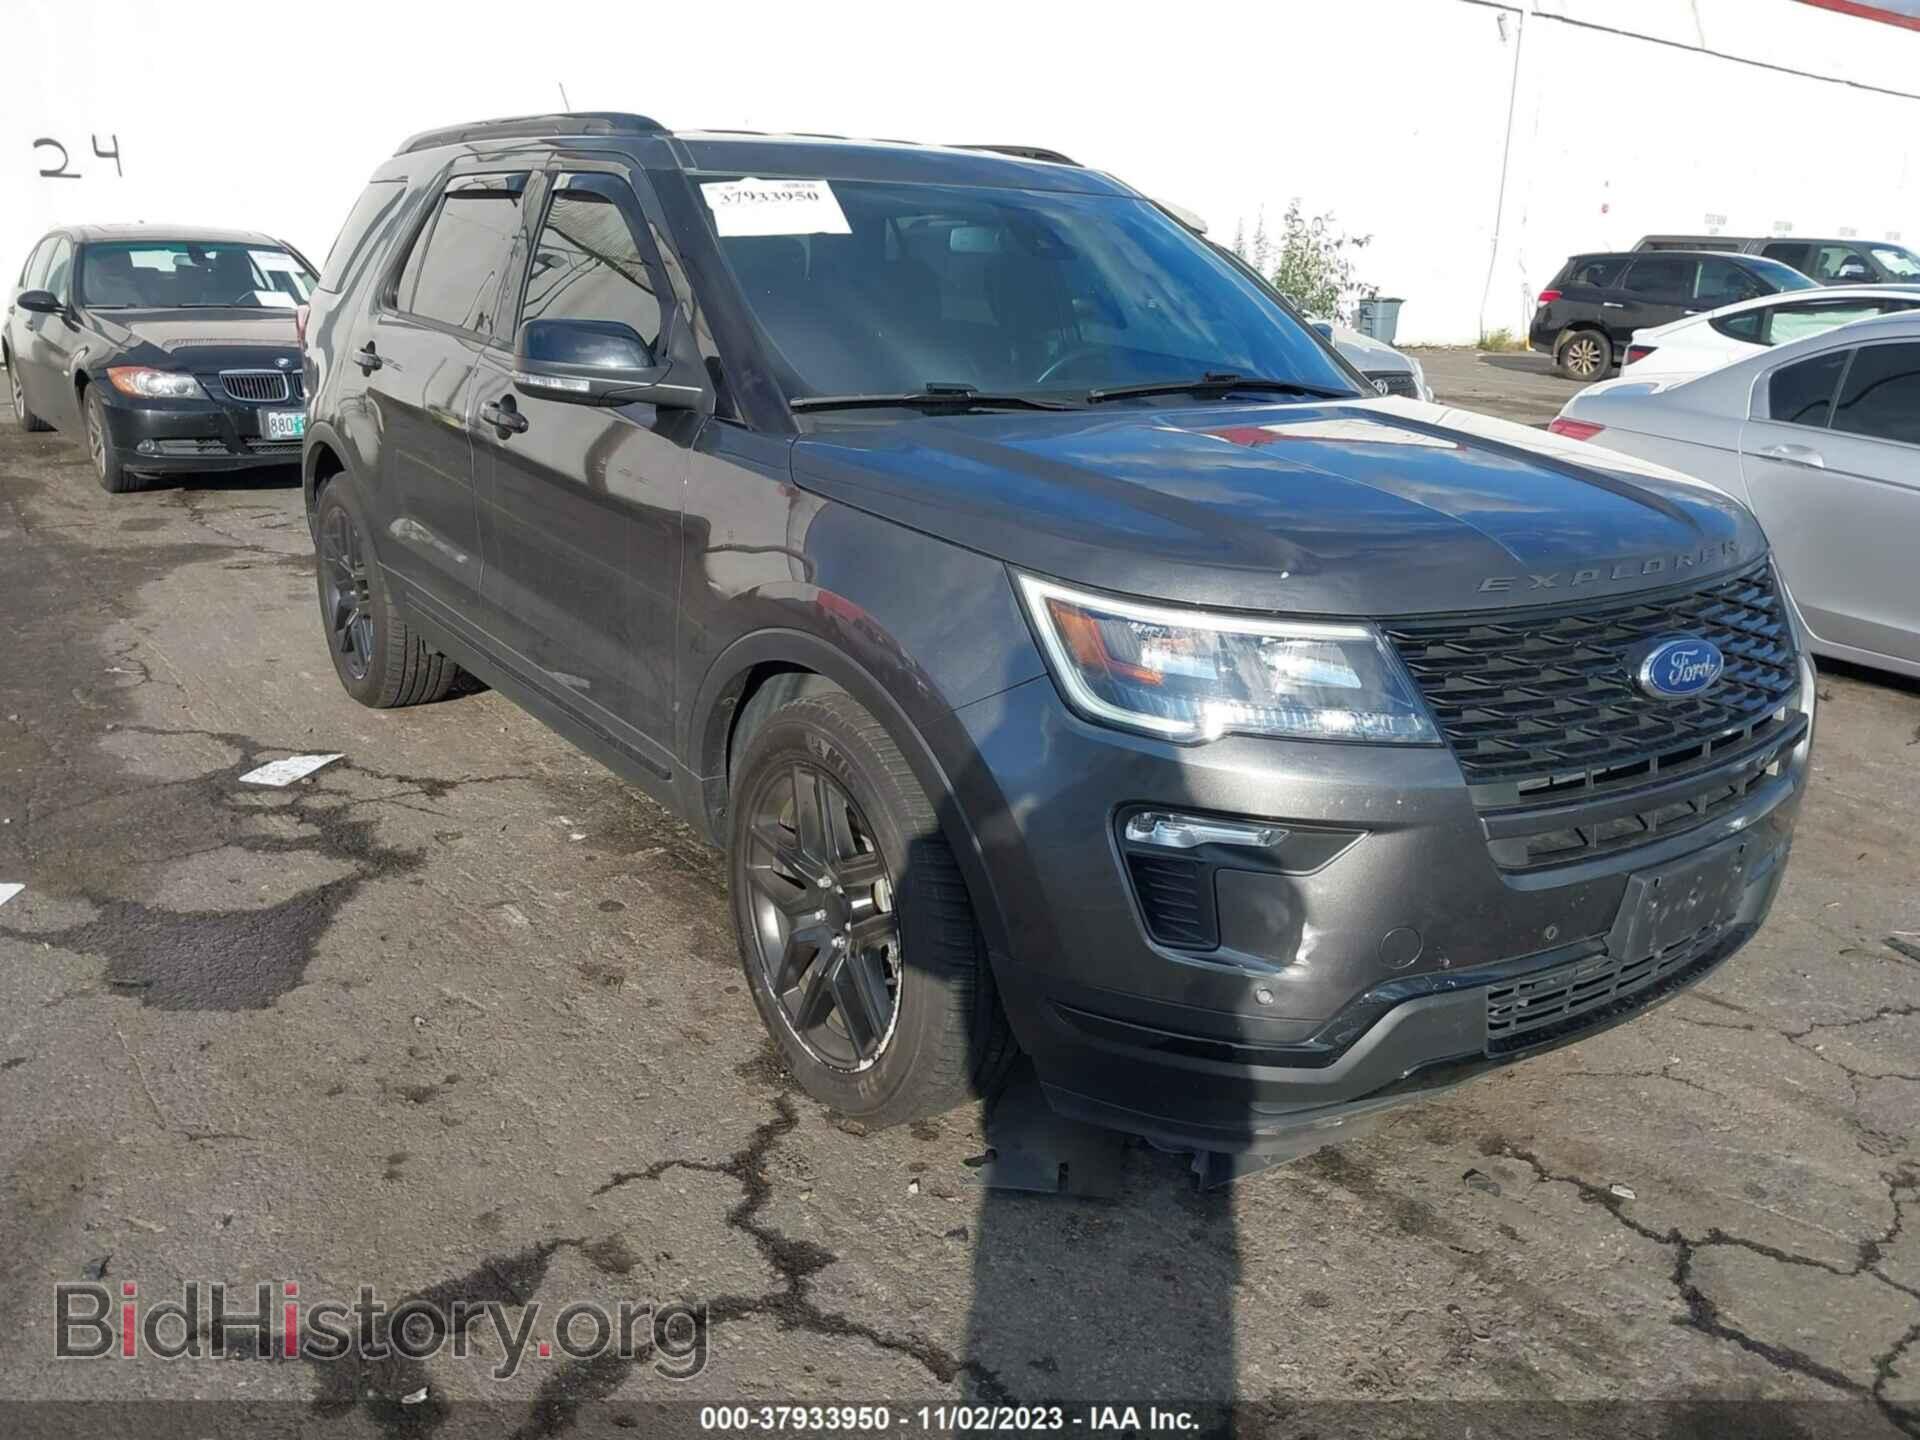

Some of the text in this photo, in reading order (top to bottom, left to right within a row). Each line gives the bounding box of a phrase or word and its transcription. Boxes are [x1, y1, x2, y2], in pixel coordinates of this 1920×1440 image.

[33, 133, 122, 179] 24
[720, 190, 820, 206] 37933950
[1476, 540, 1739, 593] EXPLORER
[1668, 649, 1719, 686] Ford
